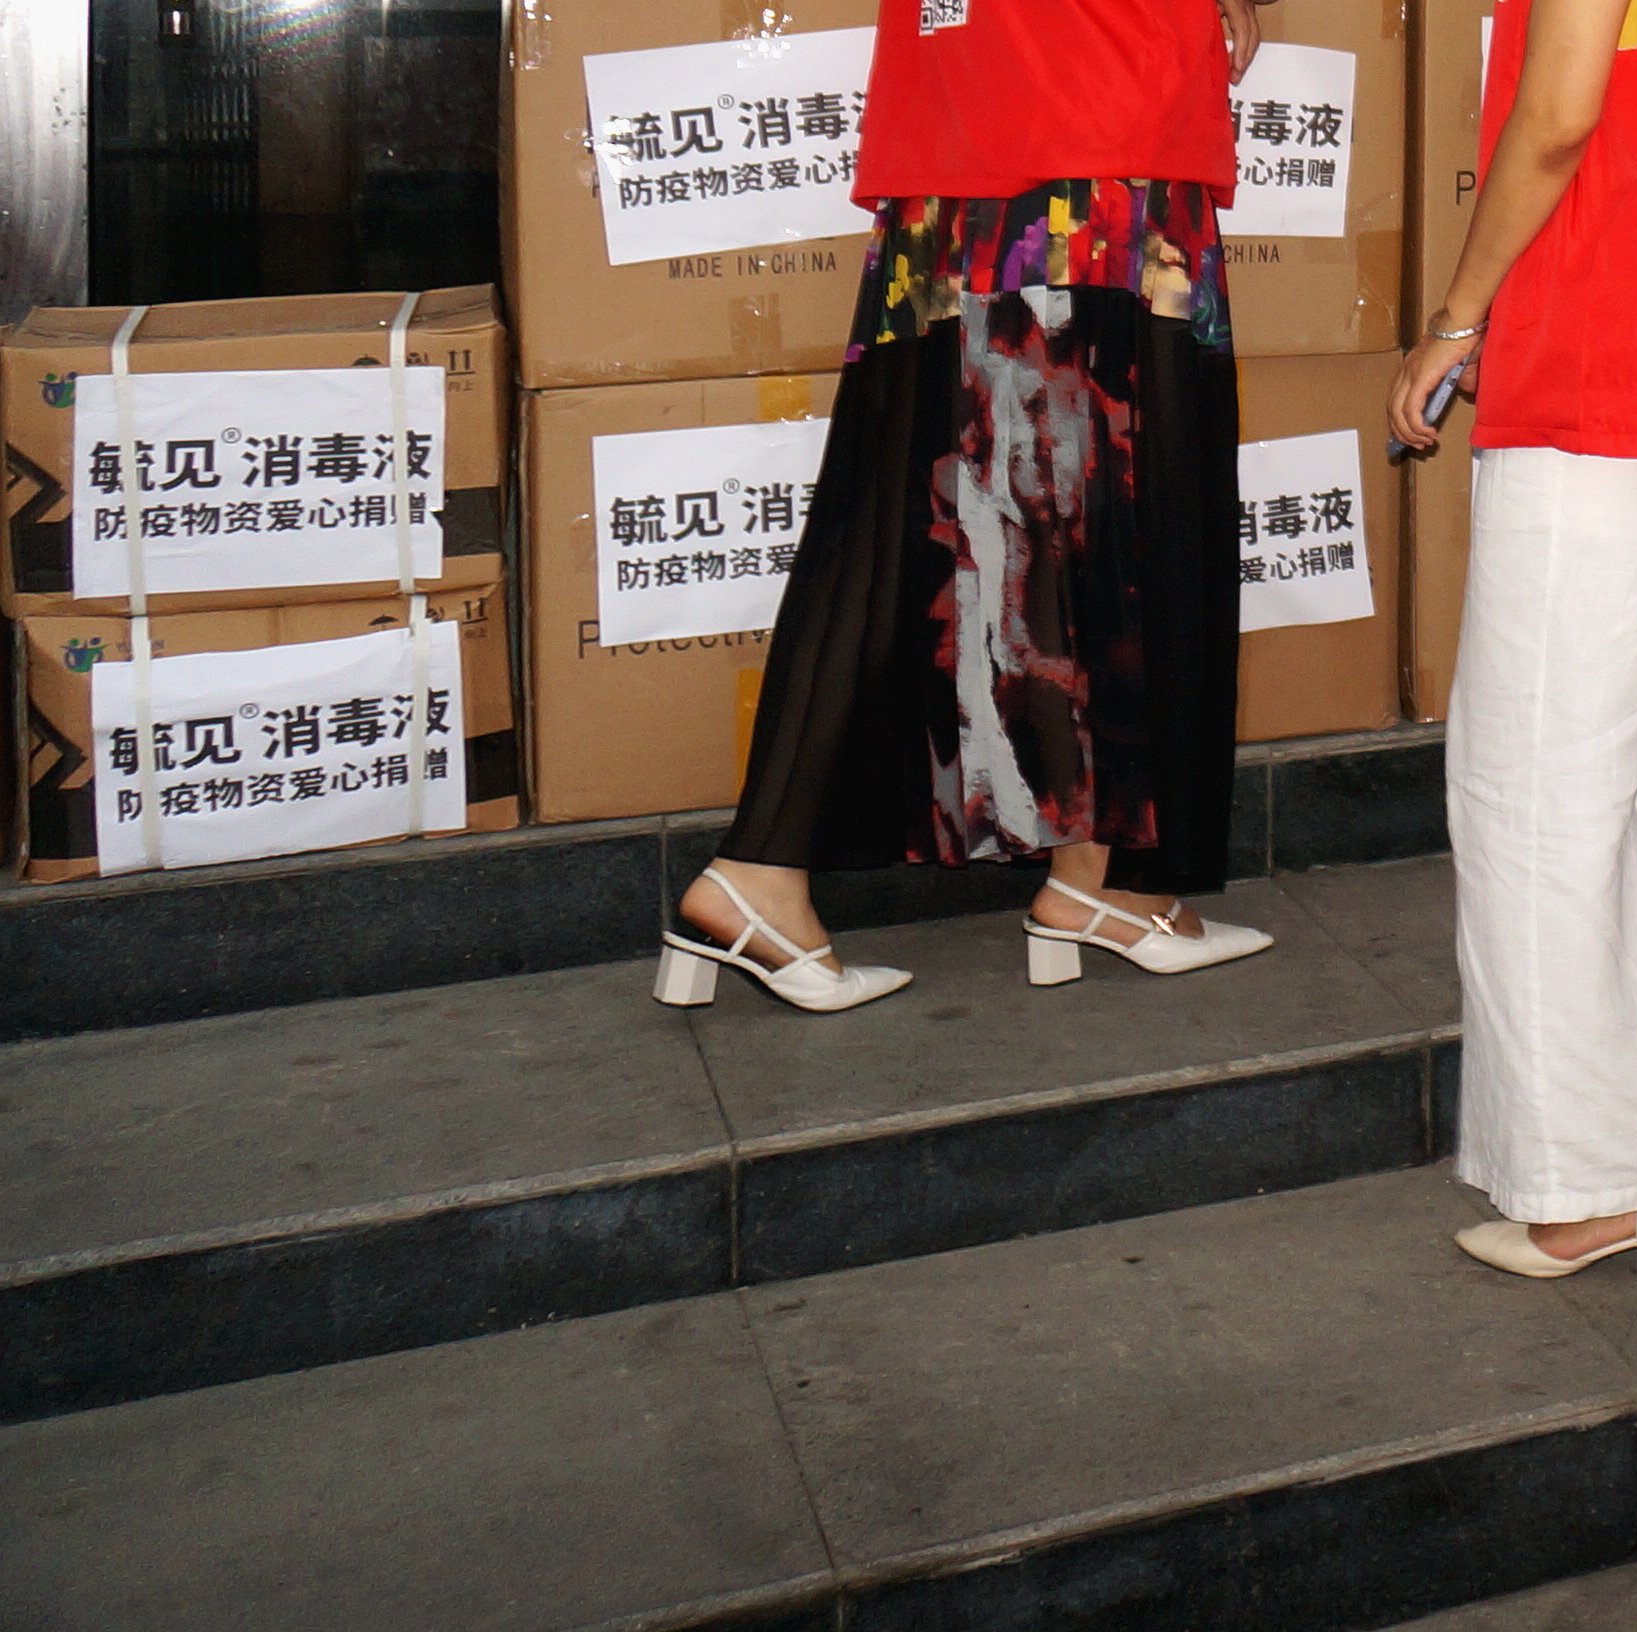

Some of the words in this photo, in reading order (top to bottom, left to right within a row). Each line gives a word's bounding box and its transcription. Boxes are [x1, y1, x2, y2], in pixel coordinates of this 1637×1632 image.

[1236, 156, 1335, 188] 心捐赠
[669, 257, 722, 279] MADE
[737, 255, 759, 276] IN
[771, 252, 837, 273] CHINA
